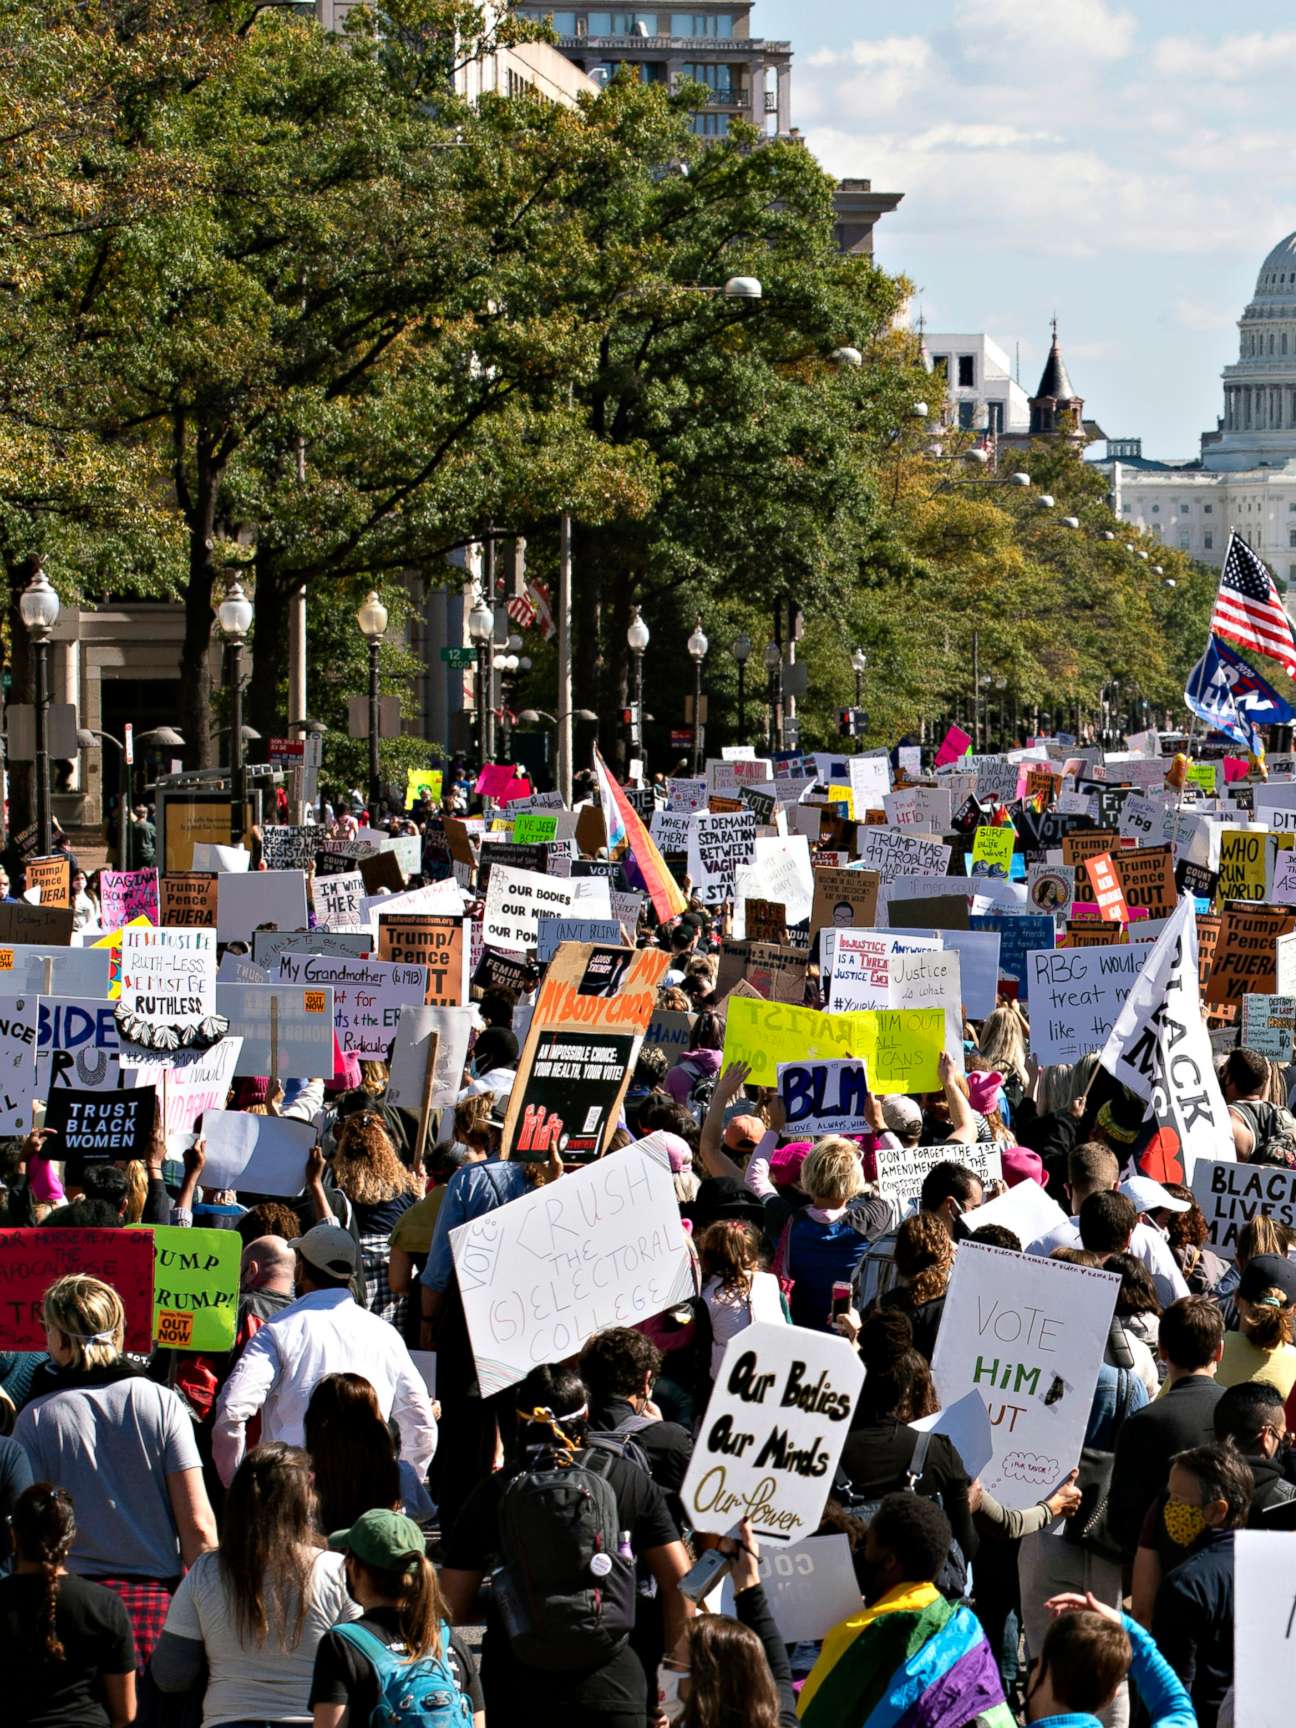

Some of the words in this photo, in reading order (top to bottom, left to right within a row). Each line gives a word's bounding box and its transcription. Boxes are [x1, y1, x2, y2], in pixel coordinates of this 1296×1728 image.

[661, 818, 689, 830] WHEN
[699, 819, 707, 831] I
[711, 815, 755, 830] DEMAND
[1128, 812, 1152, 832] rbg
[656, 830, 689, 843] THERE
[698, 829, 756, 847] SEPARATION
[979, 829, 1005, 837] SURF
[700, 843, 754, 860] BETWEEN
[869, 831, 916, 851] TRUMP
[919, 841, 943, 856] HAS
[1068, 838, 1116, 850] Trump/
[1221, 838, 1260, 862] WHO
[324, 857, 348, 866] COUNT
[867, 846, 883, 863] 99
[886, 849, 947, 872] PROBLEMS
[1118, 855, 1167, 872] Trump/
[30, 864, 65, 877] Trump/
[589, 865, 620, 877] VOTE
[1122, 872, 1165, 885] Pence
[1186, 866, 1212, 883] COUNT
[1218, 864, 1245, 883] RUN
[32, 877, 62, 888] Pence
[165, 881, 211, 893] Trump/
[320, 881, 338, 897] I'M
[344, 879, 364, 895] WITH
[923, 883, 948, 893] men
[1184, 876, 1197, 886] ON
[1198, 879, 1209, 889] US
[167, 892, 207, 906] Pence
[508, 884, 532, 897] OUR
[536, 889, 571, 905] BODIES
[1126, 886, 1165, 906] OUT
[1218, 883, 1265, 901] WORLD
[327, 897, 357, 914] HER
[501, 904, 526, 916] OUR
[162, 909, 213, 925] ¡FUERA
[1227, 914, 1287, 933] Trump/
[386, 928, 454, 947] Trump/
[488, 925, 512, 938] OUR
[1226, 932, 1277, 949] Pence
[839, 935, 887, 952] INJUSTICE
[391, 948, 450, 965] Pence
[838, 954, 848, 964] IS
[849, 955, 855, 965] A
[1213, 952, 1276, 975] ¡FUERA
[280, 957, 300, 982] My
[304, 958, 387, 984] Grandmother
[629, 951, 672, 986] MY
[833, 971, 868, 982] JUSTICE
[894, 958, 948, 984] Justice
[1035, 955, 1088, 984] RBG
[1100, 955, 1146, 975] would
[491, 972, 524, 989] VOTER
[1225, 977, 1257, 998] YA!
[354, 991, 376, 1007] for
[902, 988, 914, 1000] is
[919, 986, 945, 997] what
[1049, 984, 1105, 1009] treat
[559, 993, 609, 1025] BODY
[38, 1004, 119, 1050] BIDE
[361, 1015, 379, 1028] the
[907, 1013, 944, 1031] OUT
[1049, 1020, 1075, 1041] like
[537, 1044, 548, 1060] AN
[548, 1044, 591, 1062] IMPOSSIBLE
[592, 1047, 617, 1063] CHOICE:
[533, 1062, 552, 1077] YOUR
[552, 1063, 581, 1080] HEALTH,
[583, 1064, 601, 1080] YOUR
[601, 1065, 624, 1081] VOTE!
[782, 1063, 868, 1122] BLM
[69, 1101, 139, 1118] TRUST
[66, 1118, 136, 1133] BLACK
[786, 1122, 810, 1133] LOVE
[65, 1134, 135, 1148] WOMEN
[878, 1150, 909, 1164] DON'T
[912, 1146, 945, 1160] FORGET
[950, 1147, 971, 1158] THE
[977, 1144, 996, 1156] 1ST
[968, 1157, 987, 1168] THE
[516, 1158, 653, 1259] CRUSH
[1214, 1196, 1294, 1226] LIVES
[160, 1249, 220, 1272] UMP
[549, 1240, 599, 1276] THE
[156, 1289, 235, 1310] RUMP!
[162, 1318, 188, 1331] OUT
[529, 1278, 666, 1362] COLLEGE
[978, 1295, 1064, 1353] VOTE
[158, 1330, 191, 1343] NOW
[973, 1356, 1042, 1395] HiM
[727, 1350, 776, 1405] Our
[780, 1360, 851, 1422] Bodies
[707, 1414, 755, 1457] Our
[753, 1425, 830, 1477] Minds
[693, 1465, 743, 1515] Our
[740, 1476, 803, 1531] Power
